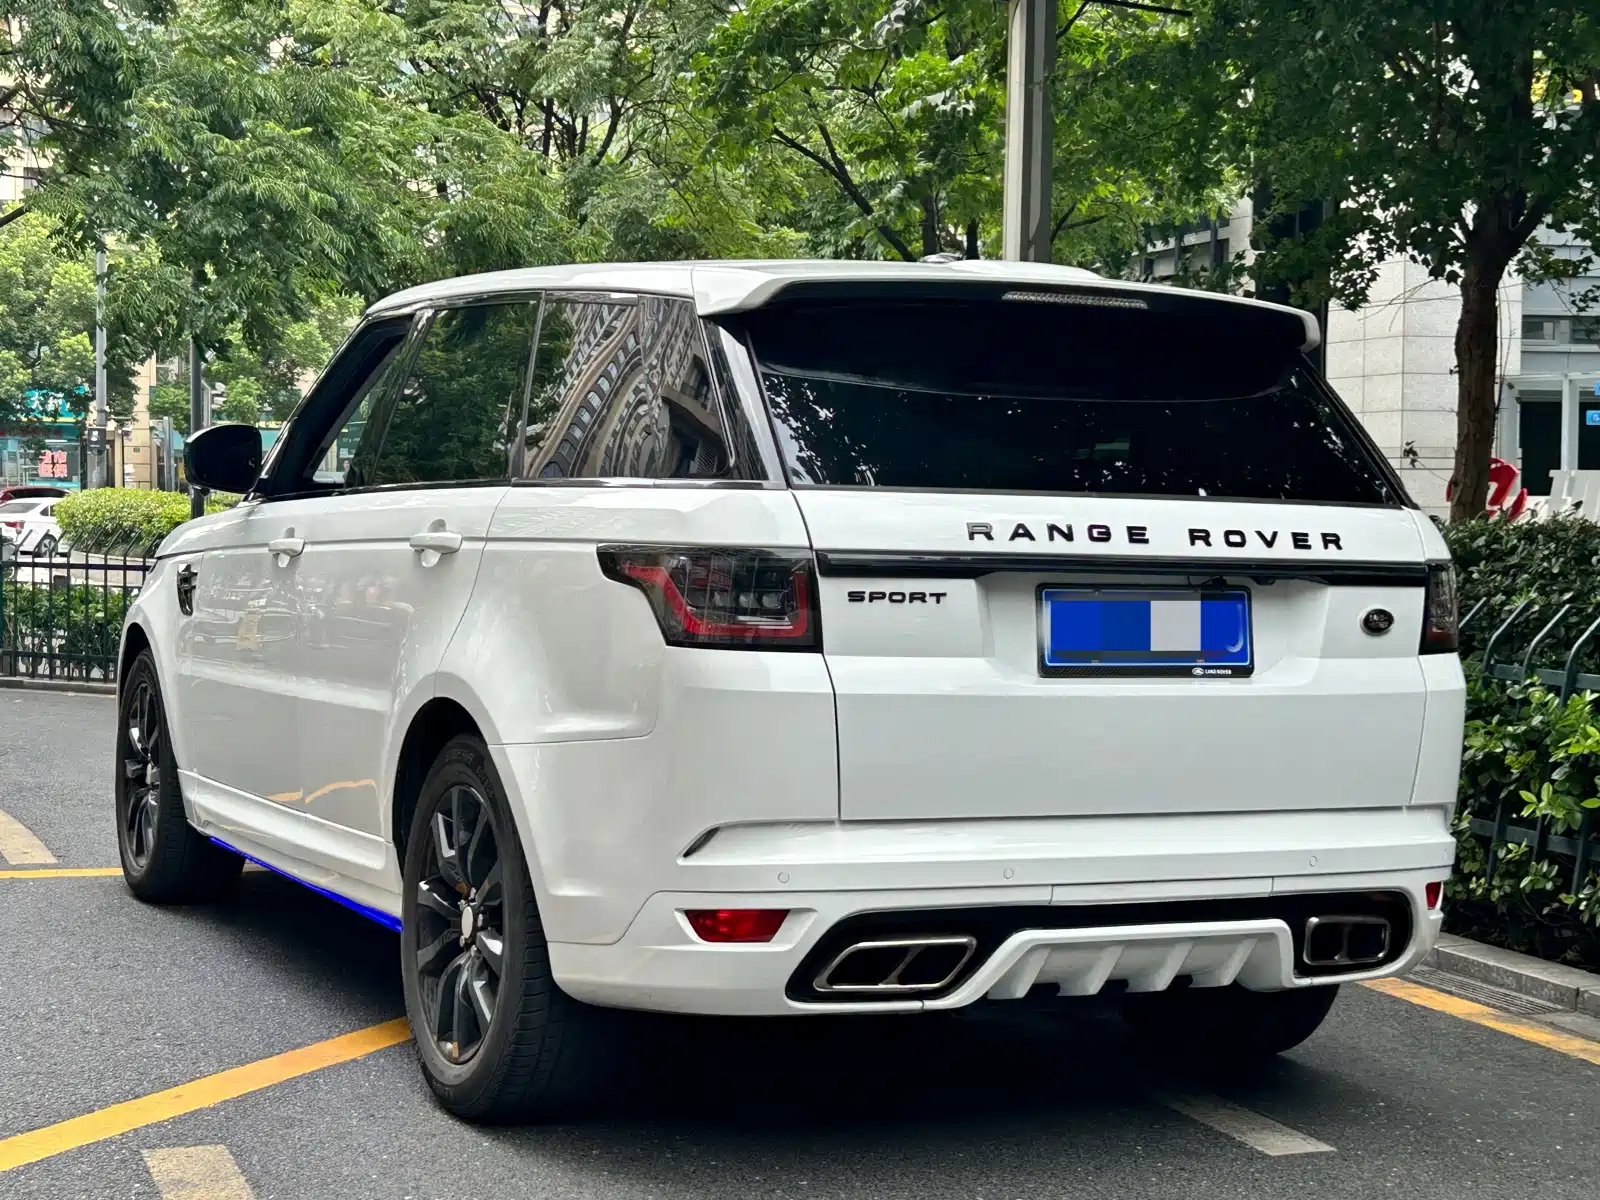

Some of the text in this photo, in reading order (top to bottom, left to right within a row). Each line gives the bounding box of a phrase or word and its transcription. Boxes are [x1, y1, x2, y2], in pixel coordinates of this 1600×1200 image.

[966, 522, 1343, 550] RANGE ROVER
[847, 590, 948, 604] SPORT
